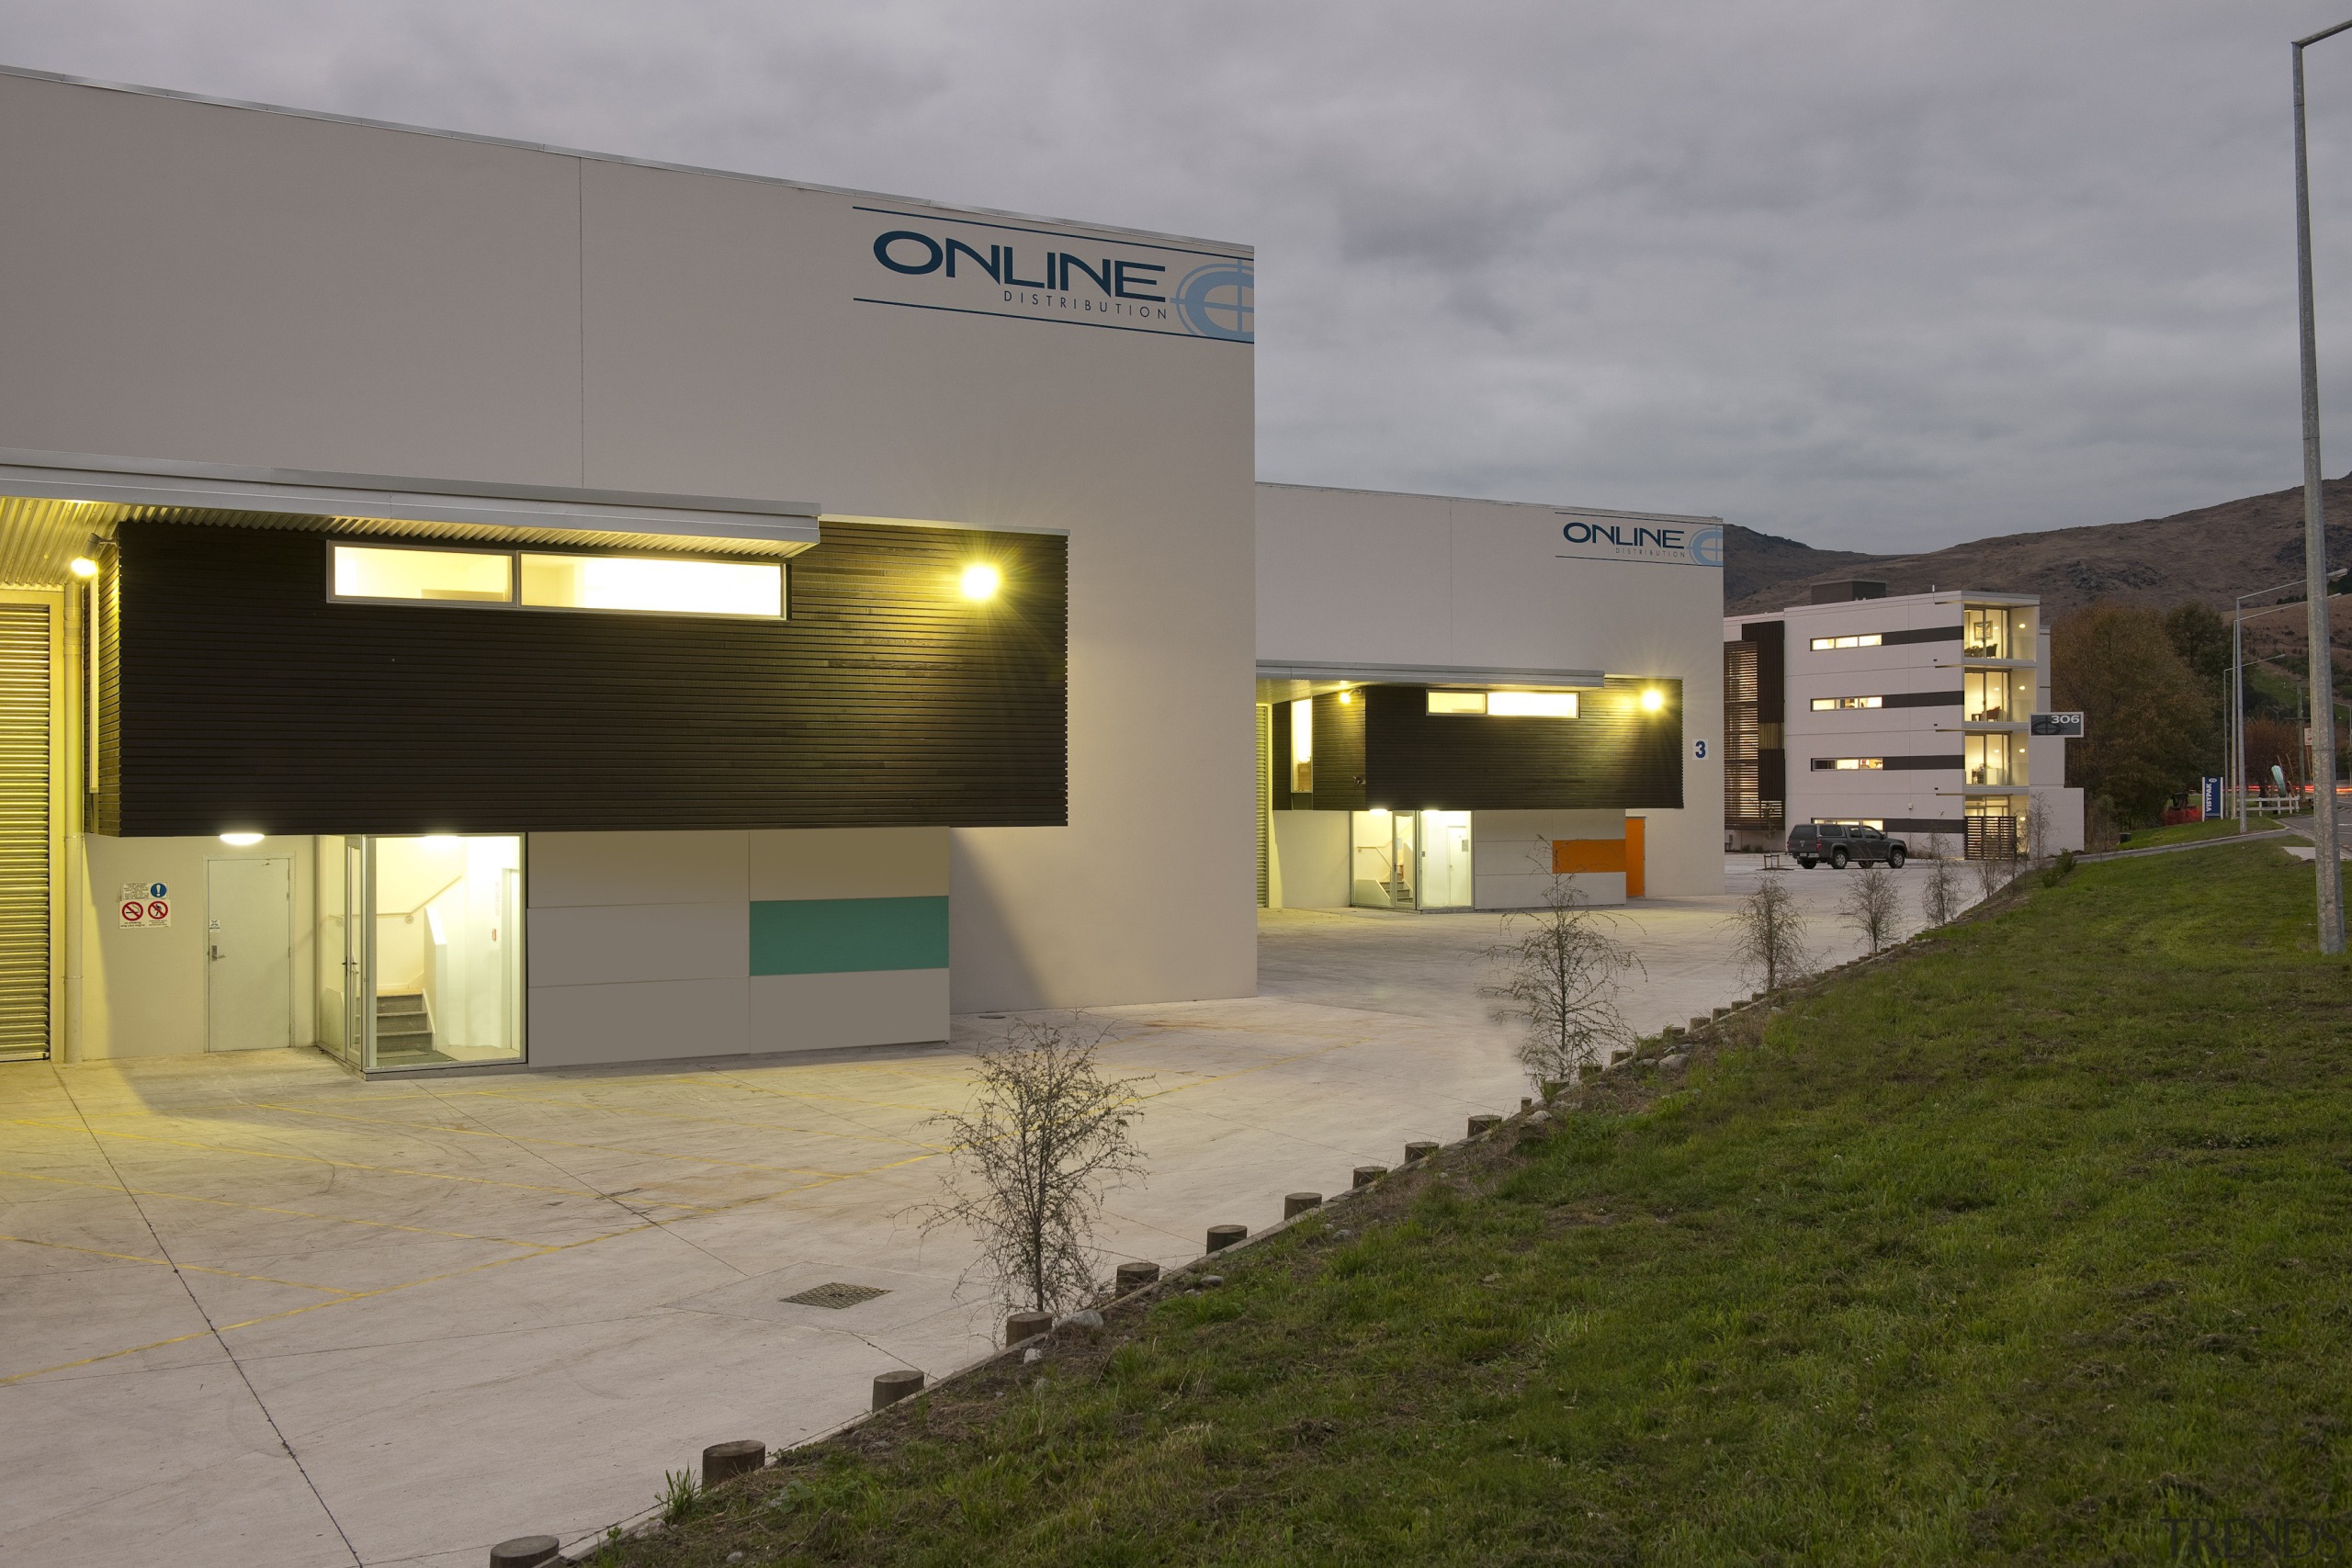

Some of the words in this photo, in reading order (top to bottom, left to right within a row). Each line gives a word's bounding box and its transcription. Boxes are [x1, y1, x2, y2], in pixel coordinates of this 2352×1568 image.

[873, 230, 1166, 303] ONLINE
[1004, 290, 1167, 320] DISTRIBUTION
[1563, 522, 1685, 549] ONLINE
[1615, 547, 1685, 558] DISTRIBUTION
[2051, 715, 2080, 724] 306
[1695, 740, 1706, 759] 3
